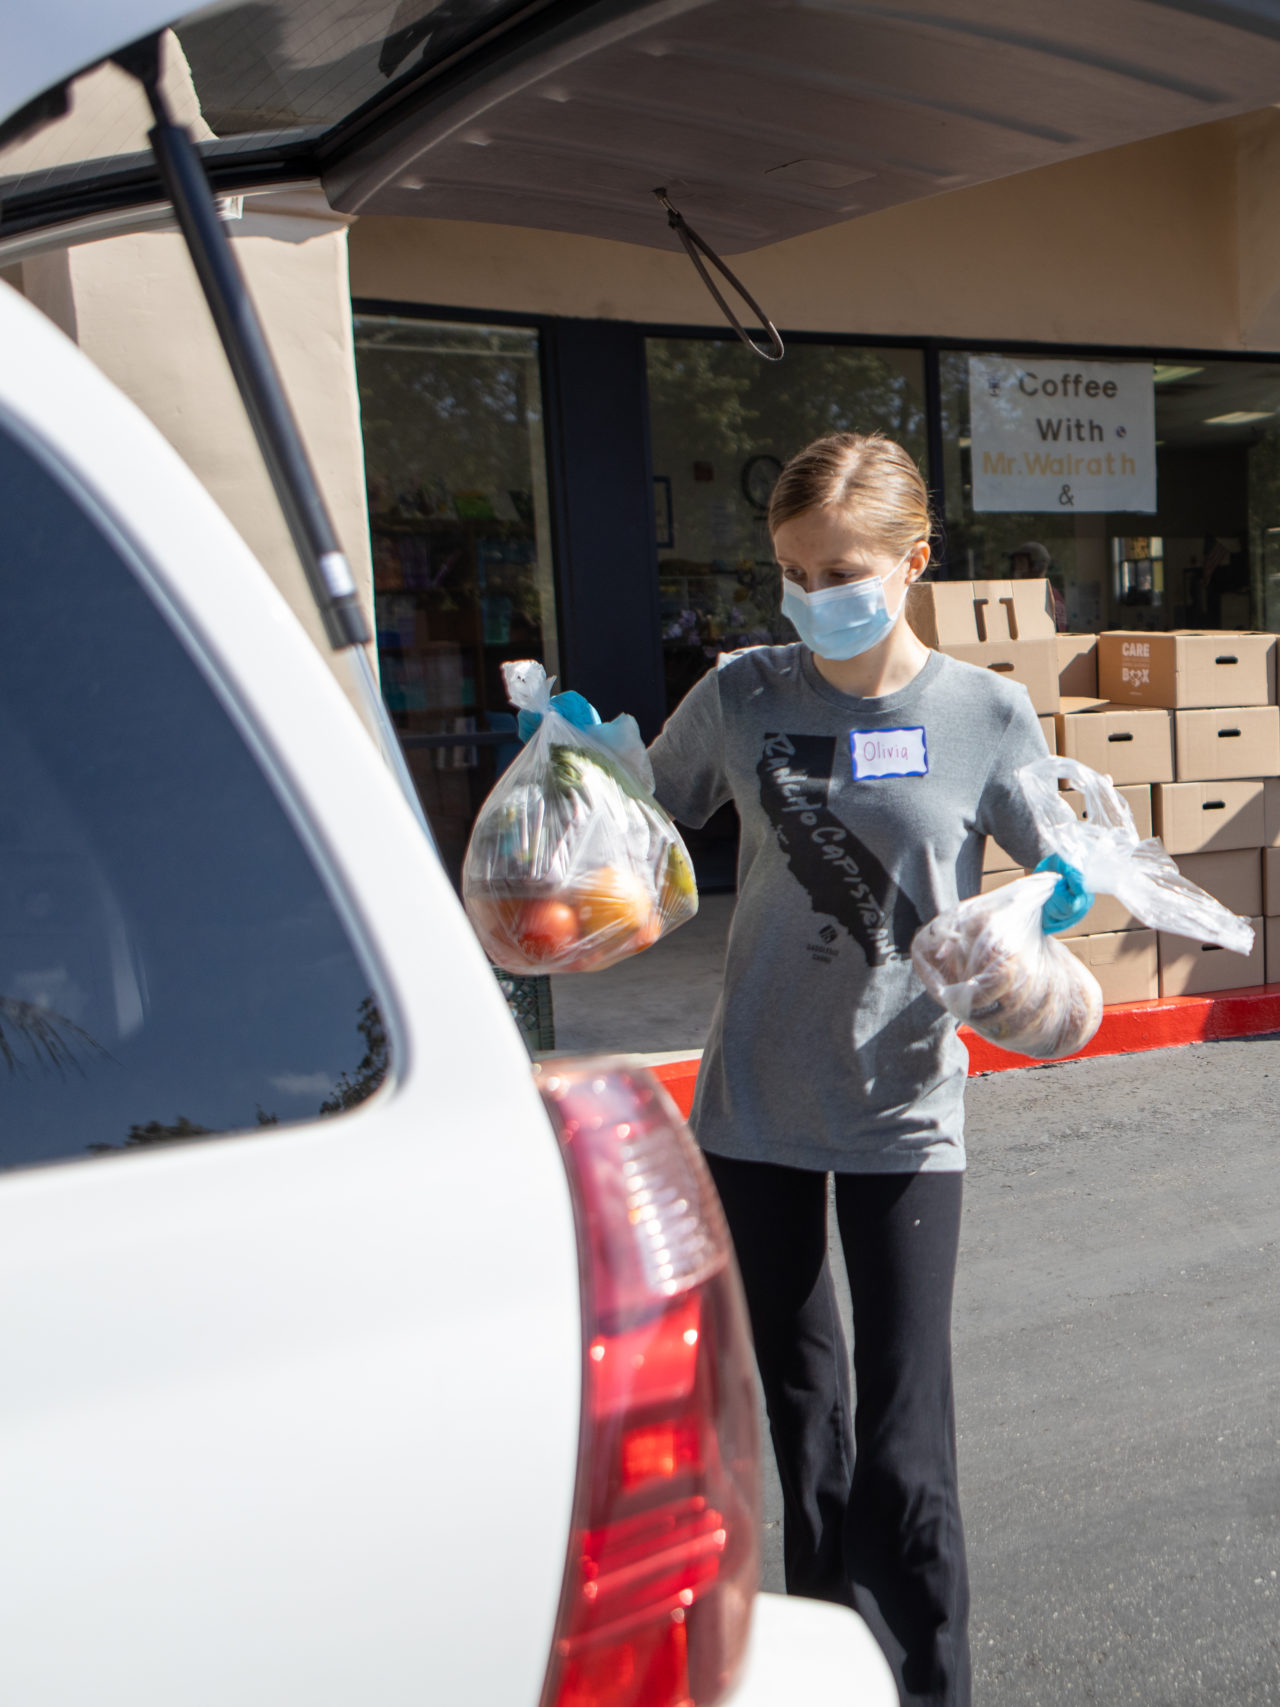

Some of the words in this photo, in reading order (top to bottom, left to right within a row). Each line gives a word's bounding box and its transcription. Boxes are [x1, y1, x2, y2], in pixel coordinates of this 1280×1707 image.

[1018, 372, 1118, 398] Coffee
[1036, 418, 1104, 442] With
[1058, 484, 1074, 506] &
[1122, 642, 1150, 657] CARE
[863, 741, 909, 762] Olivia
